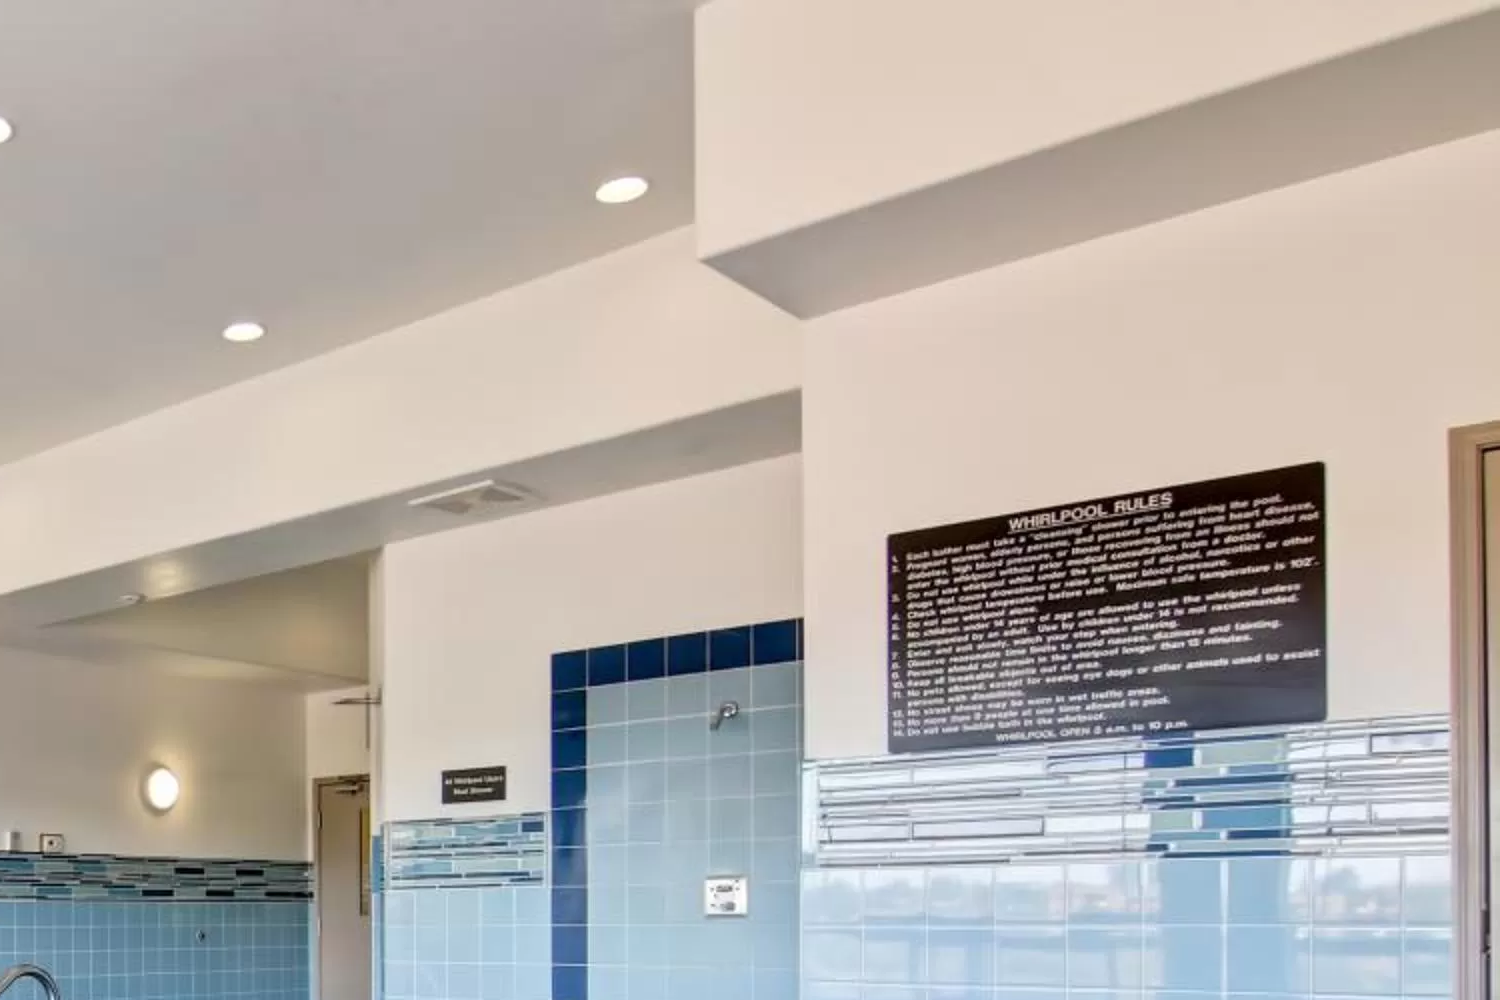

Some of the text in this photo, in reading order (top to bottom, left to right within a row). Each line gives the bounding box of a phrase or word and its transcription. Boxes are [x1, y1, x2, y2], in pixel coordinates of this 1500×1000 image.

[1008, 491, 1172, 531] WHIRLPOOL RULES
[1197, 514, 1226, 525] from
[1164, 531, 1191, 541] from
[1180, 539, 1208, 549] from
